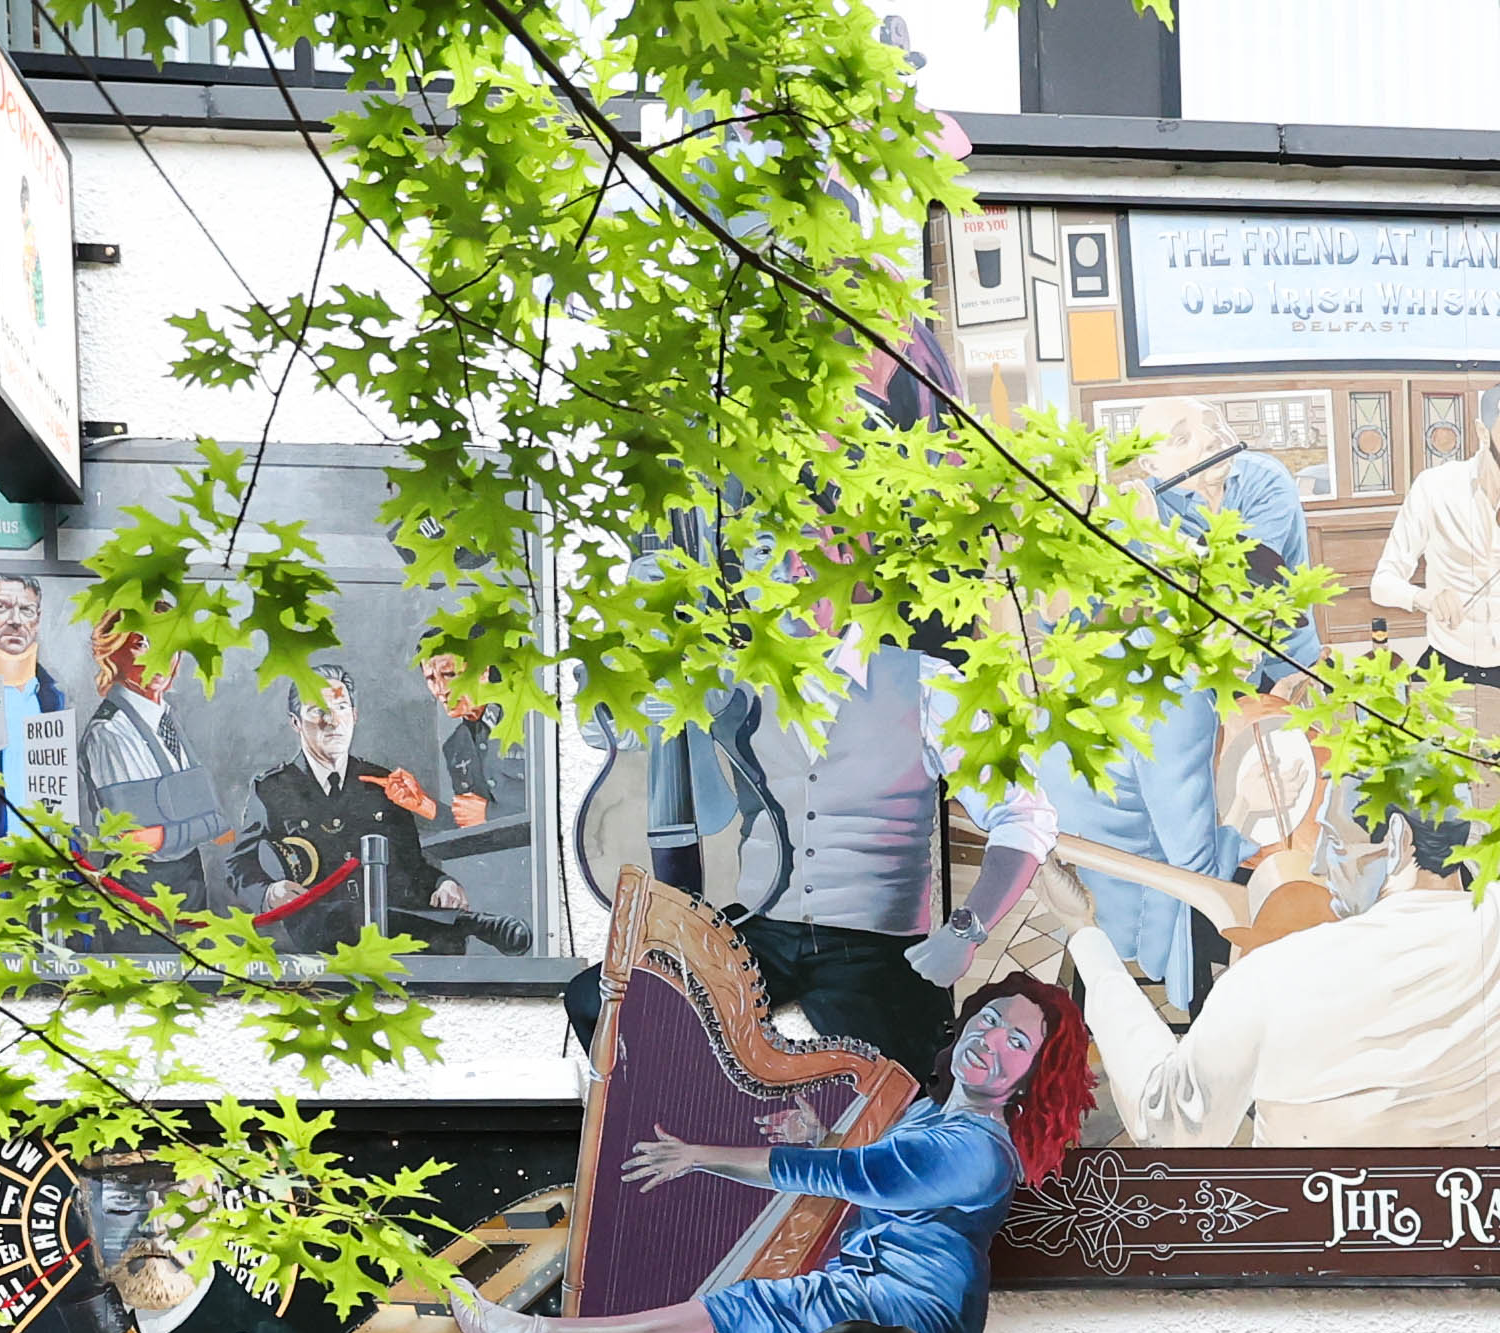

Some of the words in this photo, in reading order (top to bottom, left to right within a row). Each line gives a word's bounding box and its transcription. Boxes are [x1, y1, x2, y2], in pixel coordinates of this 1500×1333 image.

[964, 222, 985, 233] FOR
[988, 220, 1008, 231] YOU
[1159, 228, 1230, 268] THE
[1240, 224, 1359, 266] FRIEND
[1372, 228, 1416, 265] AT
[1181, 281, 1254, 315] OLD
[1267, 281, 1363, 320] IRISH
[1292, 321, 1410, 332] BELFAST
[970, 349, 1018, 361] POWERS
[27, 719, 64, 739] BROO
[28, 748, 68, 766] QUEUE
[28, 776, 68, 796] HERE
[1303, 1168, 1421, 1247] THE
[32, 1184, 63, 1267] AHEAD
